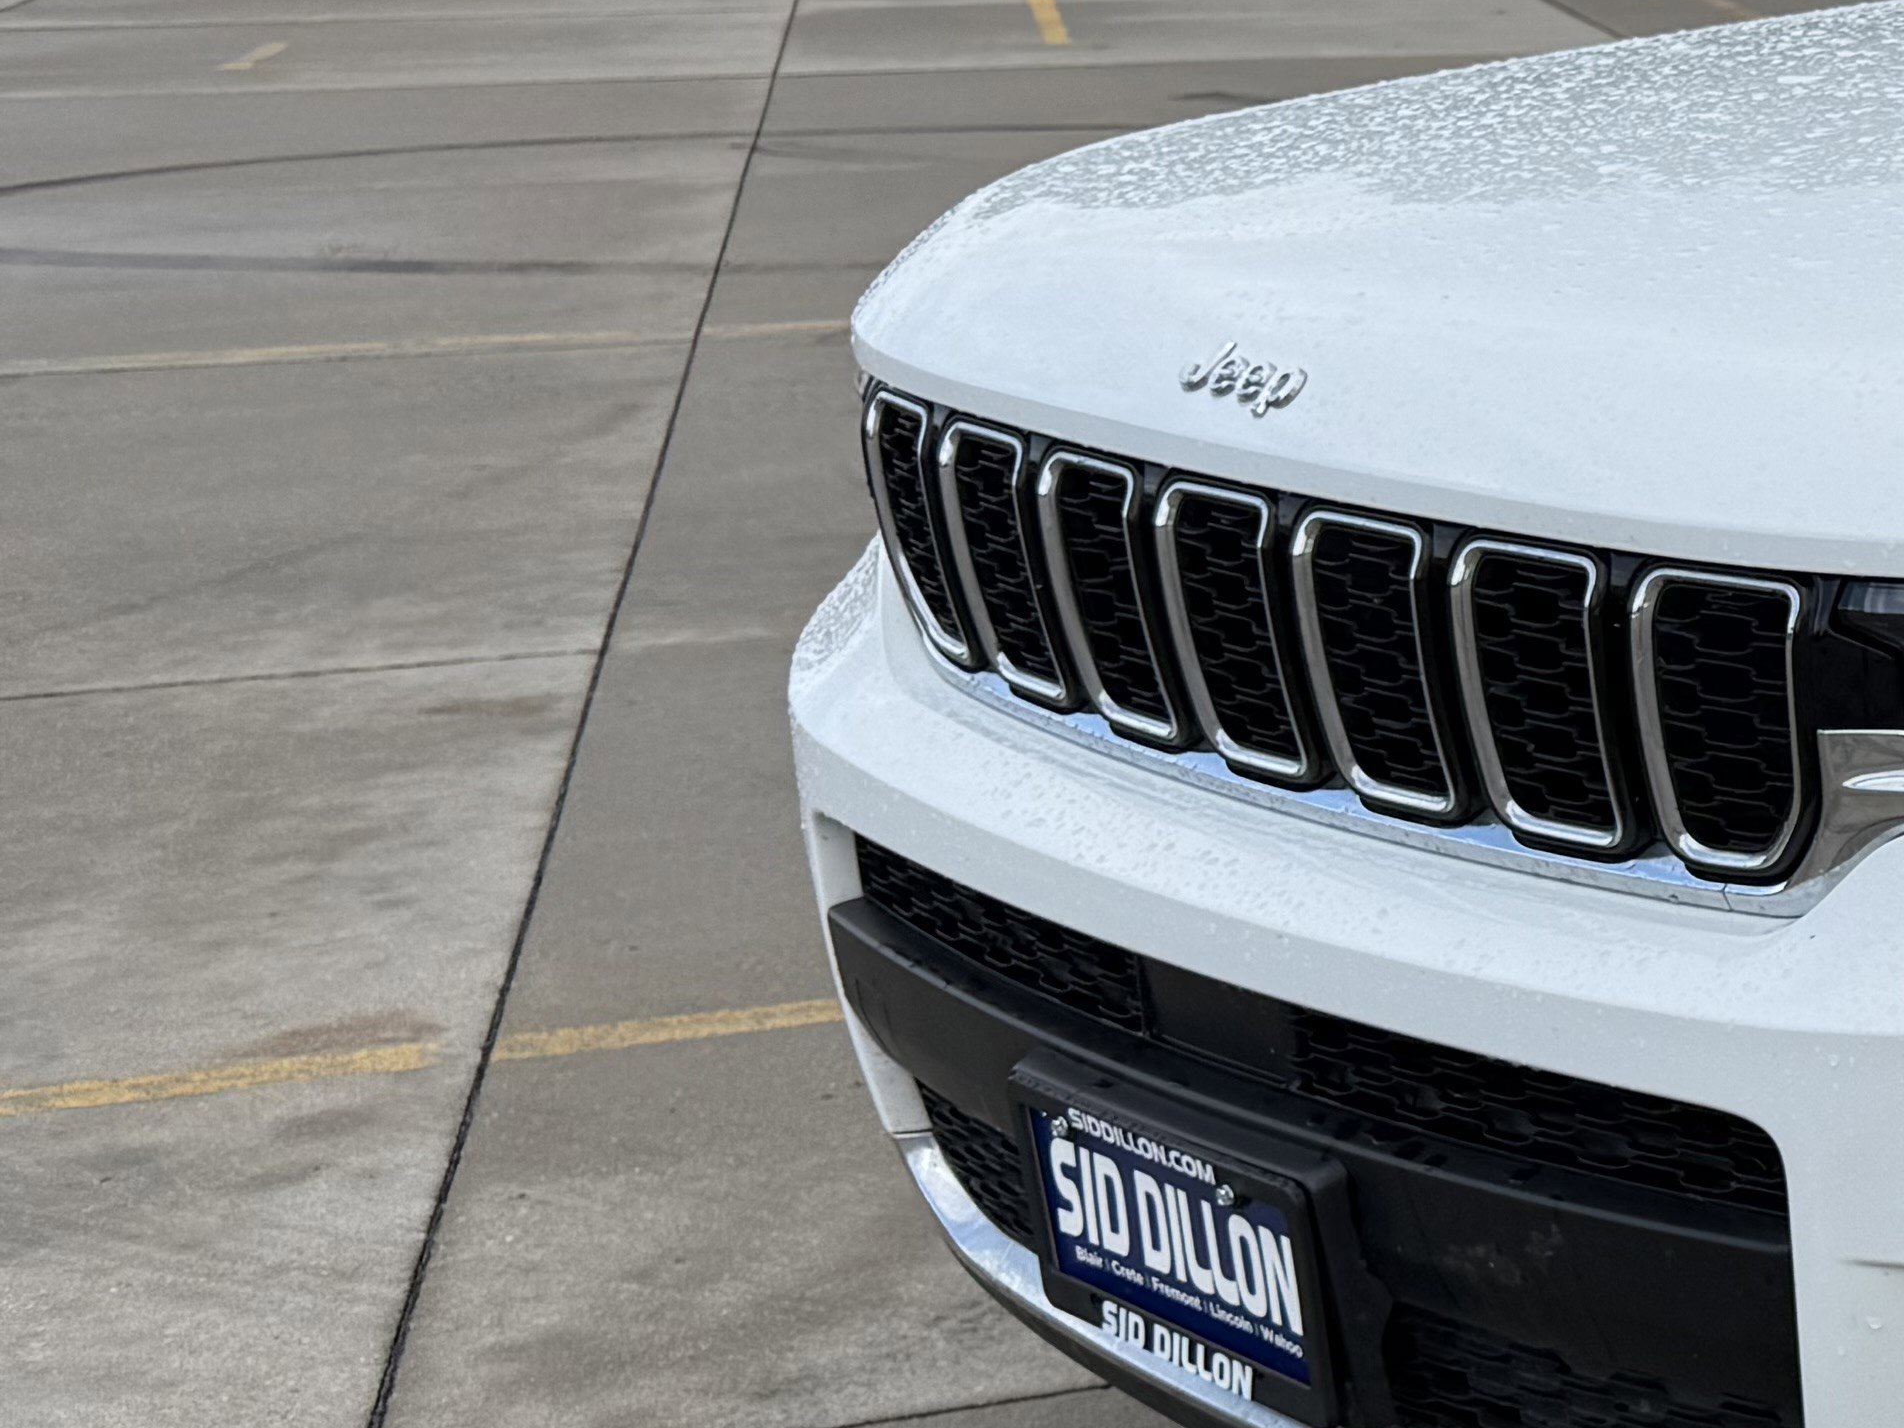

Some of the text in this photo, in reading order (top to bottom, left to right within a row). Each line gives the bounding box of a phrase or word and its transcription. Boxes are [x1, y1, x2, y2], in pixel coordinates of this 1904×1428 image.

[1178, 341, 1308, 418] Jeep
[1067, 1107, 1216, 1185] SIDDILLON.COM
[1050, 1137, 1304, 1337] SID DILLON
[1075, 1245, 1103, 1268] Blair
[1111, 1259, 1144, 1286] Crete
[1151, 1276, 1202, 1312] Fremont
[1209, 1301, 1254, 1335] Lincoln
[1101, 1299, 1253, 1401] SID DILLON
